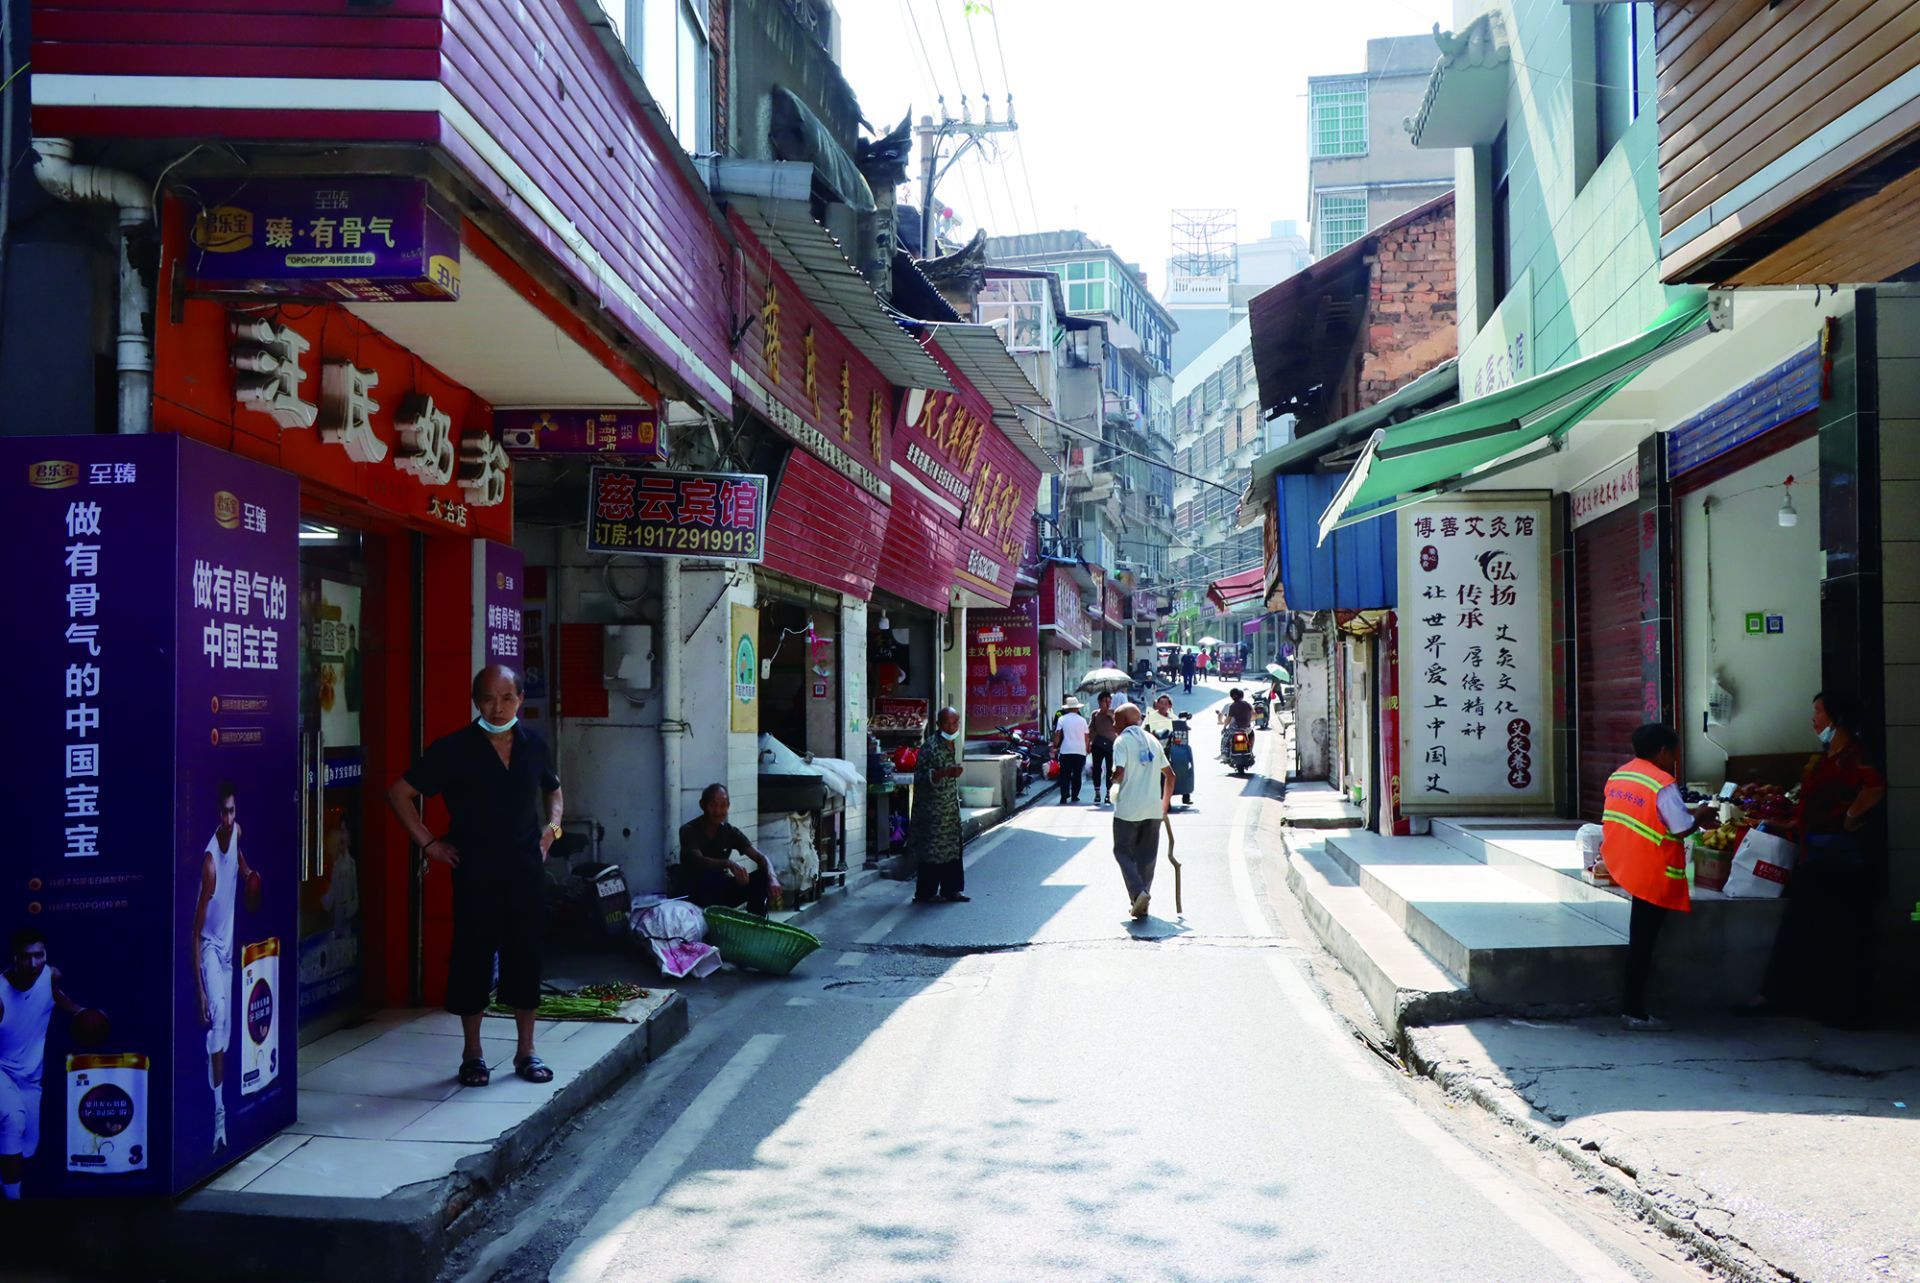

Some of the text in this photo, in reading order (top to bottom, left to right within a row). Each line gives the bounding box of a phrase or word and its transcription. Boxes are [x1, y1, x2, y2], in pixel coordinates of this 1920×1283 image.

[230, 314, 511, 508] 汪氏奶粉
[34, 463, 74, 479] 君乐宝
[596, 472, 758, 530] 慈云宾馆
[1414, 515, 1534, 538] 博善艾灸馆
[193, 559, 287, 621] 做有骨气的
[1456, 584, 1485, 629] 传承
[203, 618, 279, 670] 中国宝宝
[967, 646, 1032, 657] 主义心价值观
[65, 501, 102, 858] 做有骨气的中国宝宝
